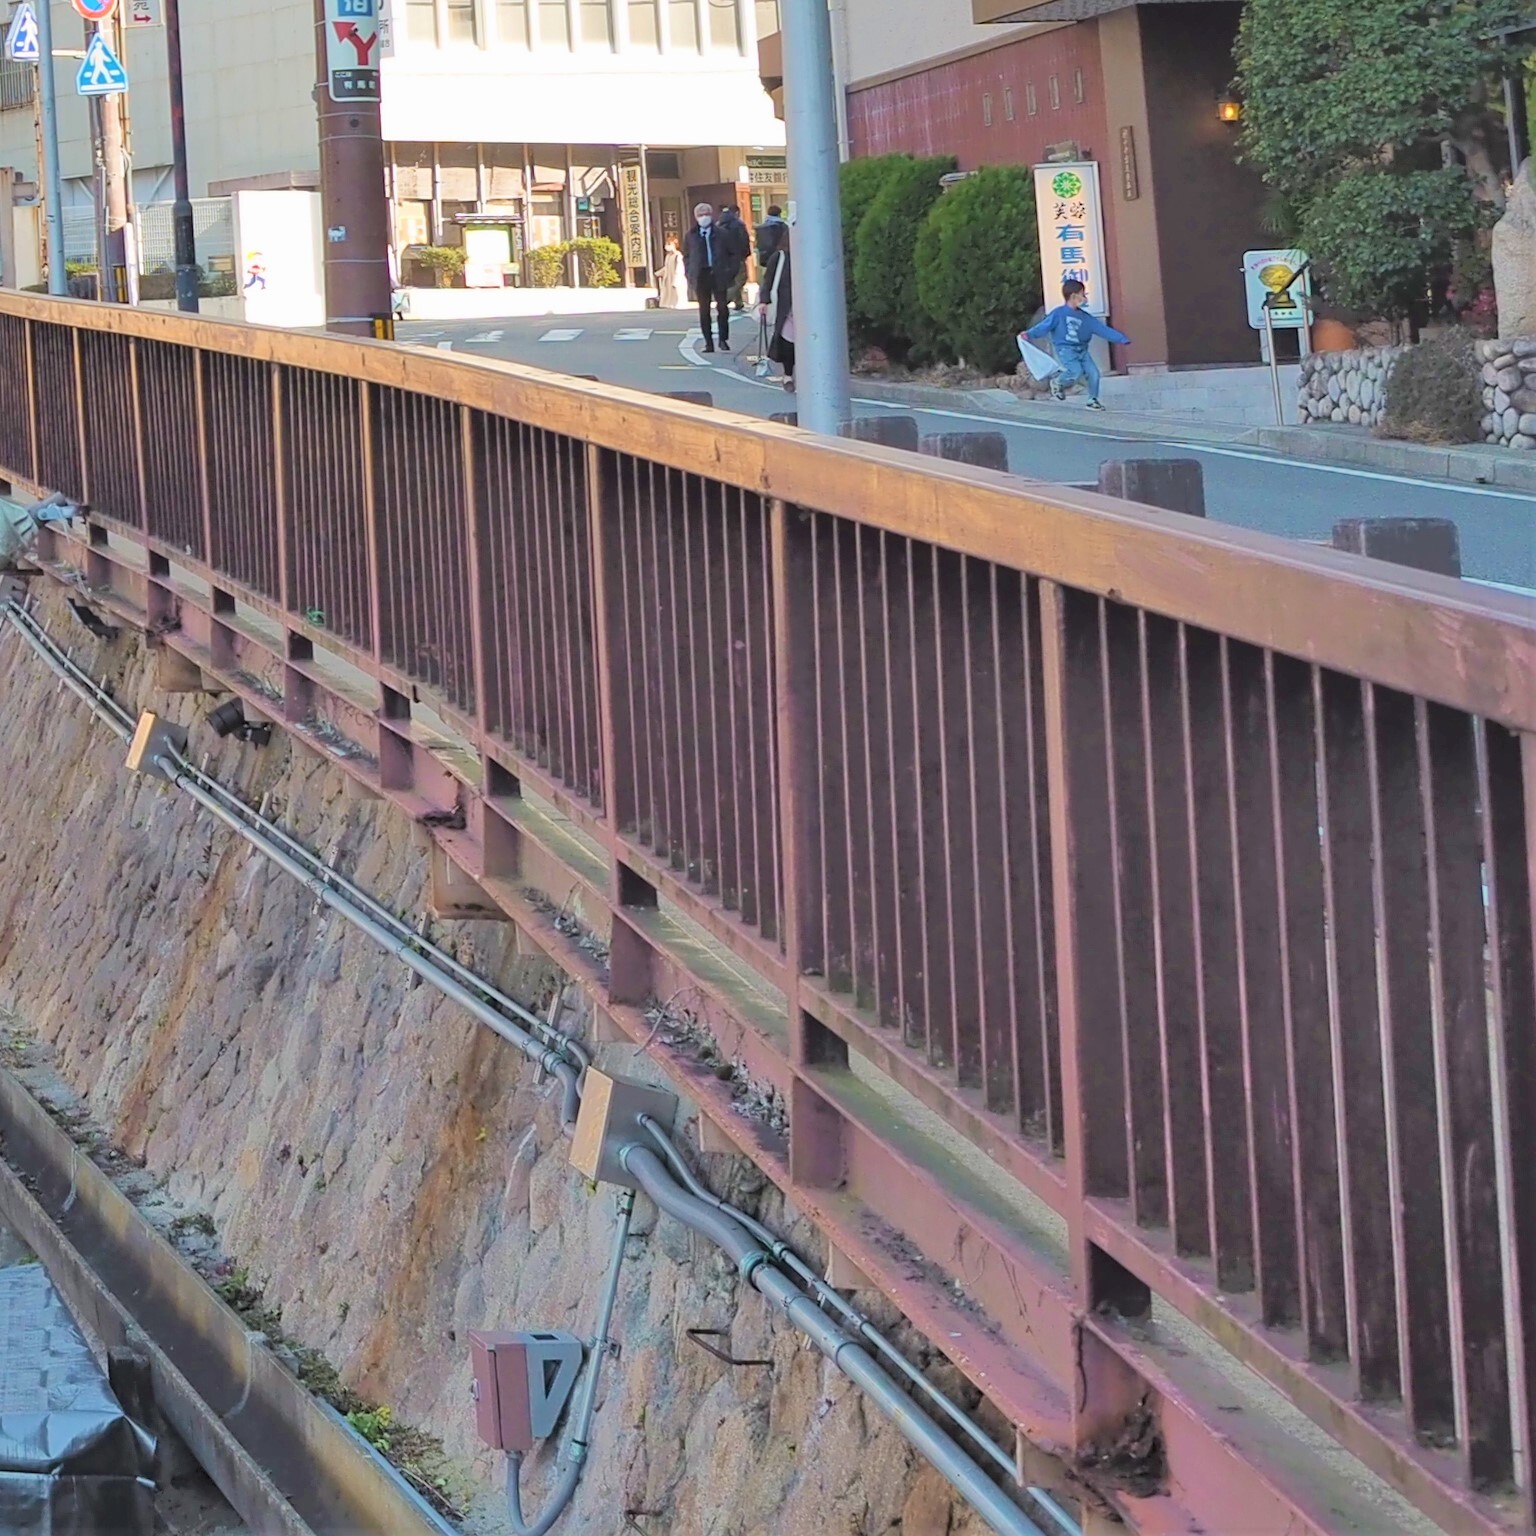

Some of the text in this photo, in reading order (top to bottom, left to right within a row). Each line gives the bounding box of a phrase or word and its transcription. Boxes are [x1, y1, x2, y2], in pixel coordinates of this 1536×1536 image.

[627, 169, 642, 263] 観光総合案内所
[1052, 201, 1087, 220] 芙蓉
[1055, 224, 1090, 308] 有馬御
